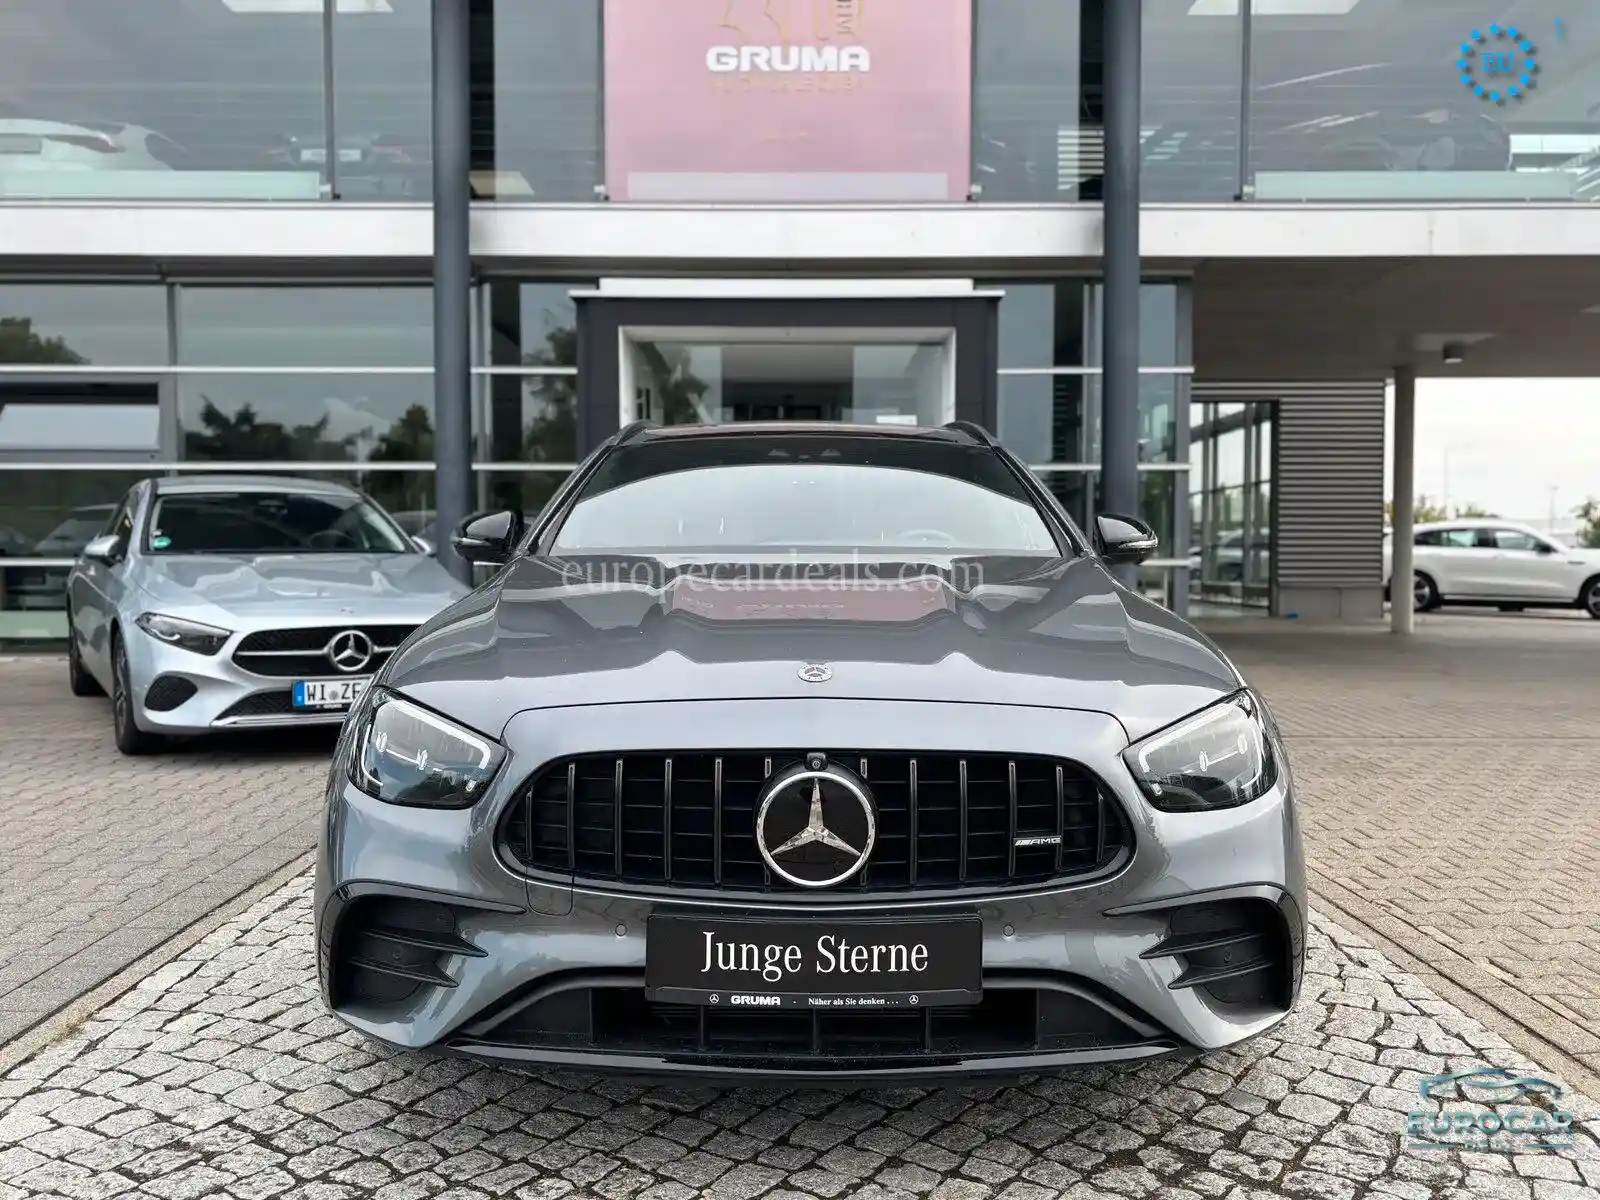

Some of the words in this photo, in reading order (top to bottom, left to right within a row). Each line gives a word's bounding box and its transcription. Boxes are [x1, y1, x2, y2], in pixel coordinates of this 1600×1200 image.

[706, 45, 870, 72] GRUMA
[1029, 837, 1061, 845] AMG
[701, 931, 802, 982] Junge
[816, 935, 928, 973] Sterne
[730, 995, 781, 1005] GRUMA
[808, 998, 831, 1006] Näher
[833, 998, 844, 1006] als
